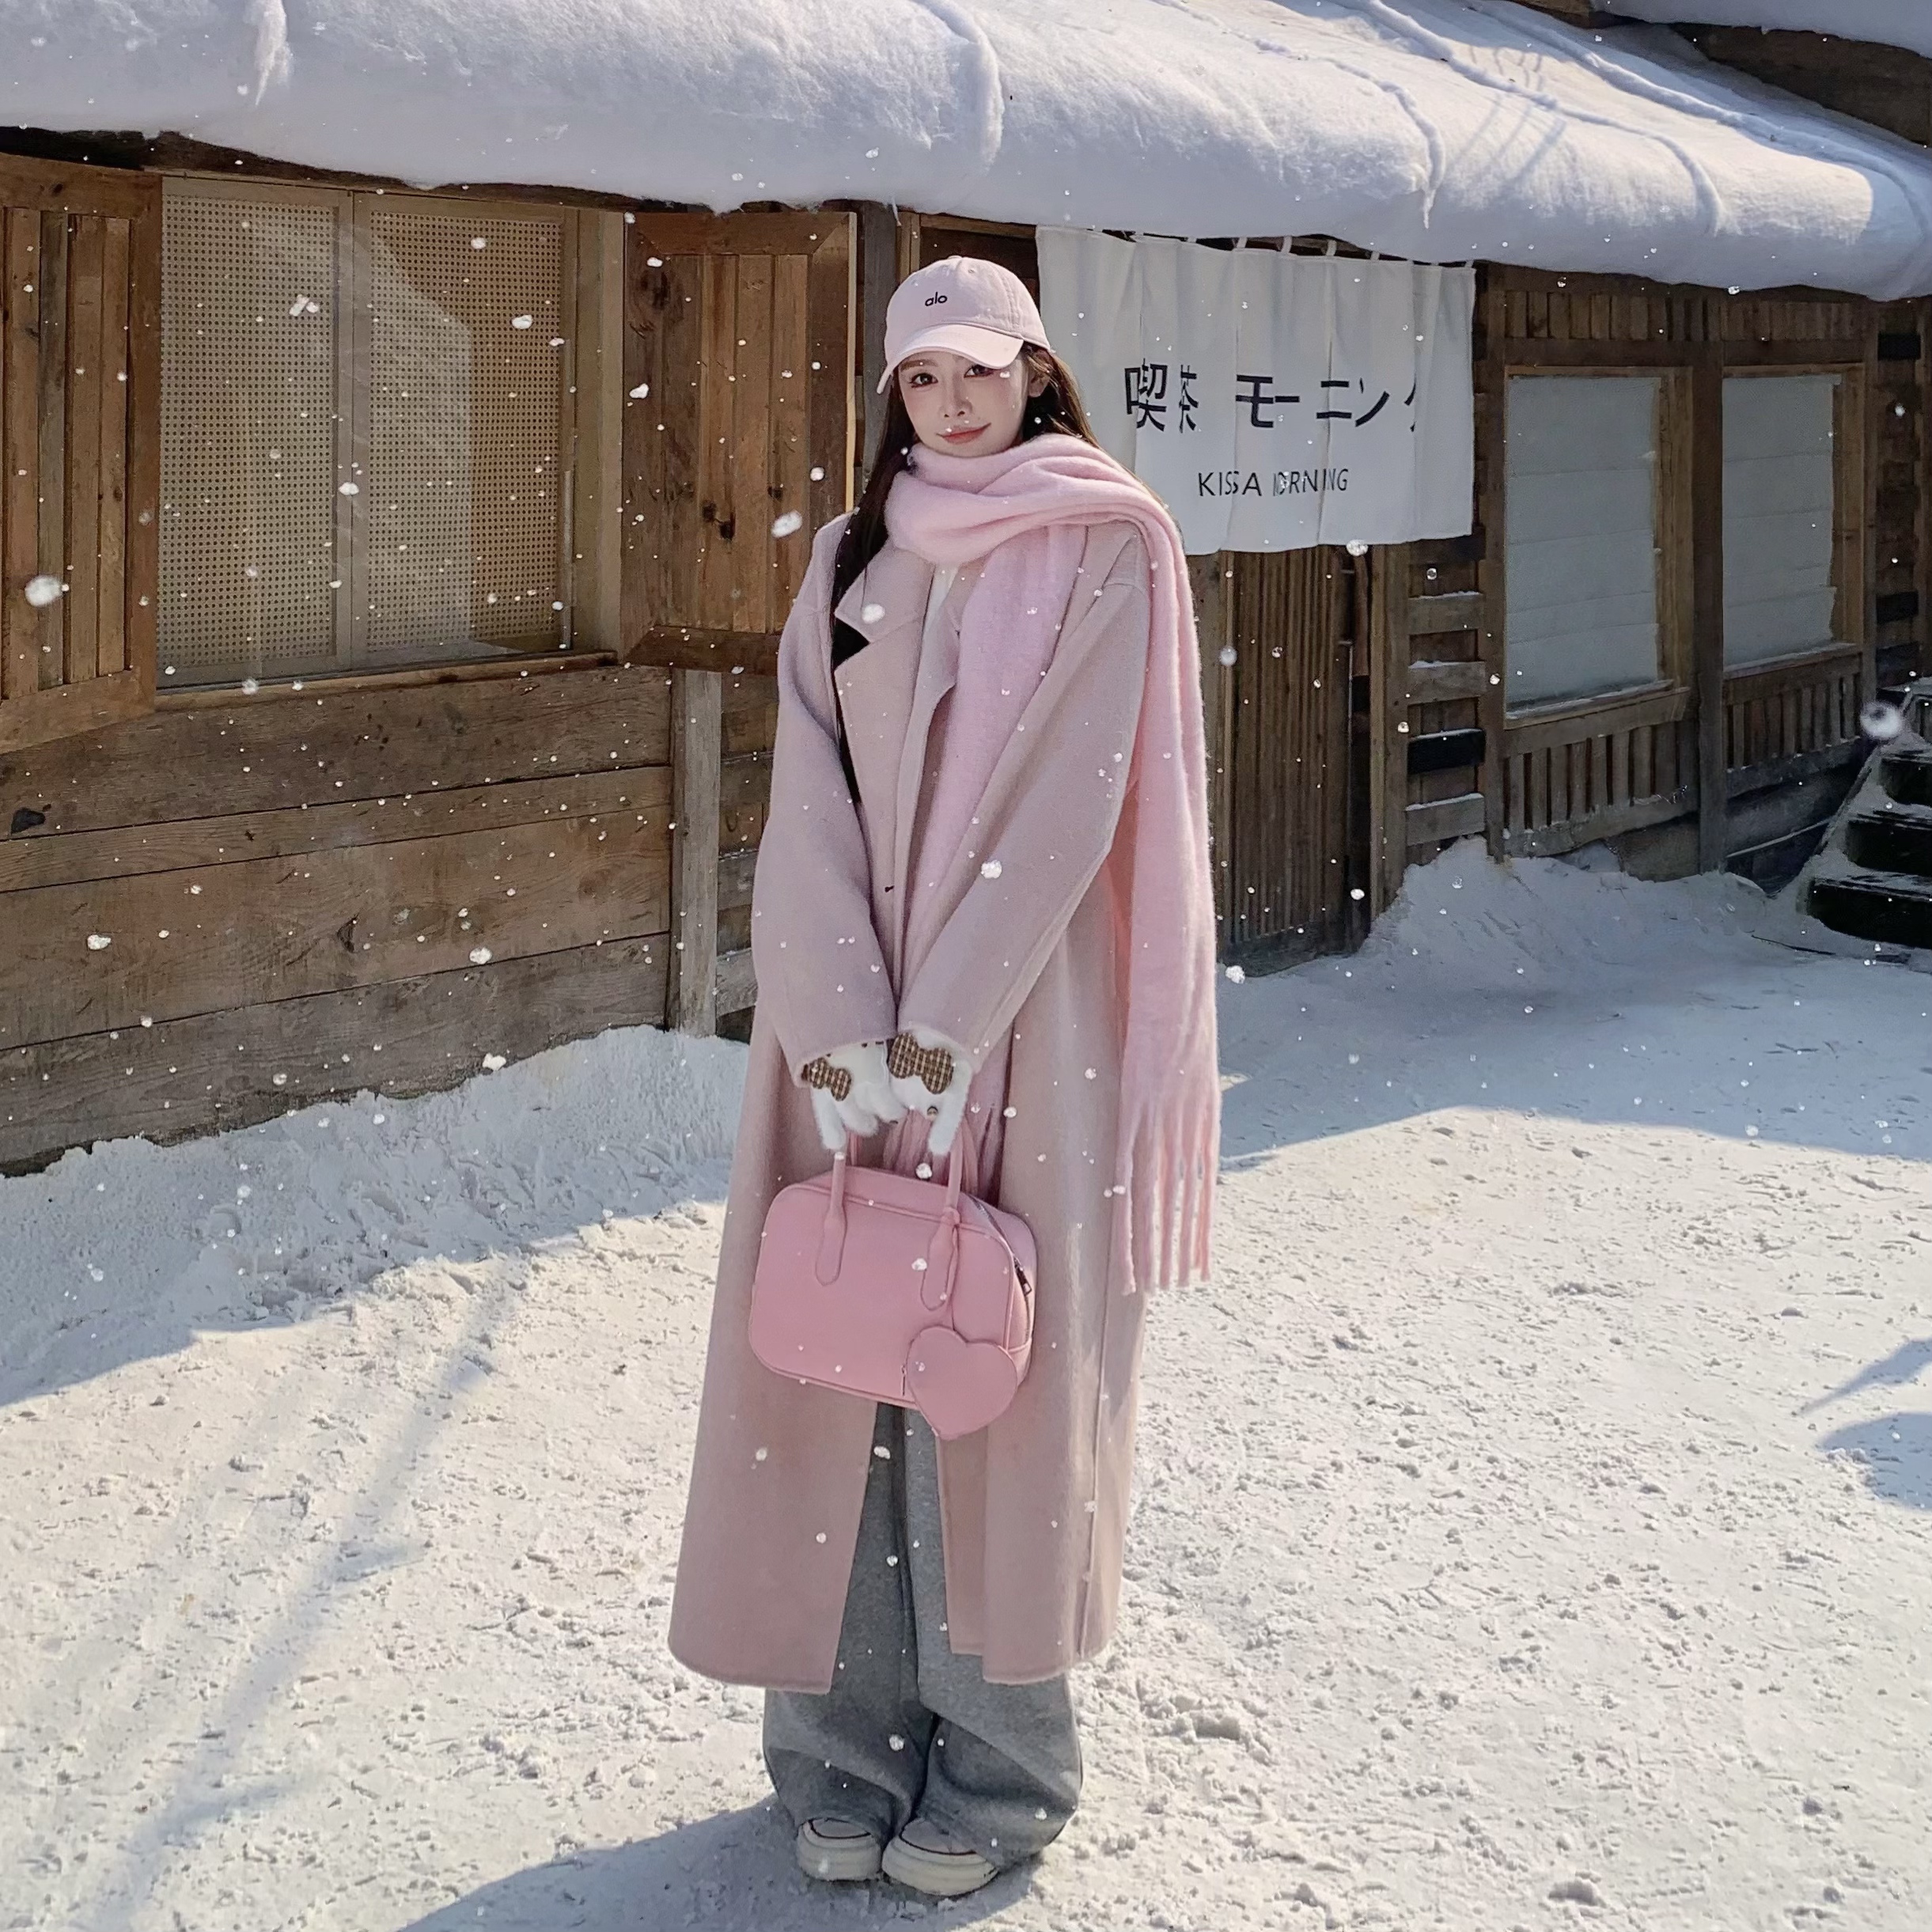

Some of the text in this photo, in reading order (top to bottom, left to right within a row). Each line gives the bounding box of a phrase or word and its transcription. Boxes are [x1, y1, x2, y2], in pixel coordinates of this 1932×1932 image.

[924, 291, 948, 307] alo
[1123, 357, 1417, 434] 喫茶 モーニン
